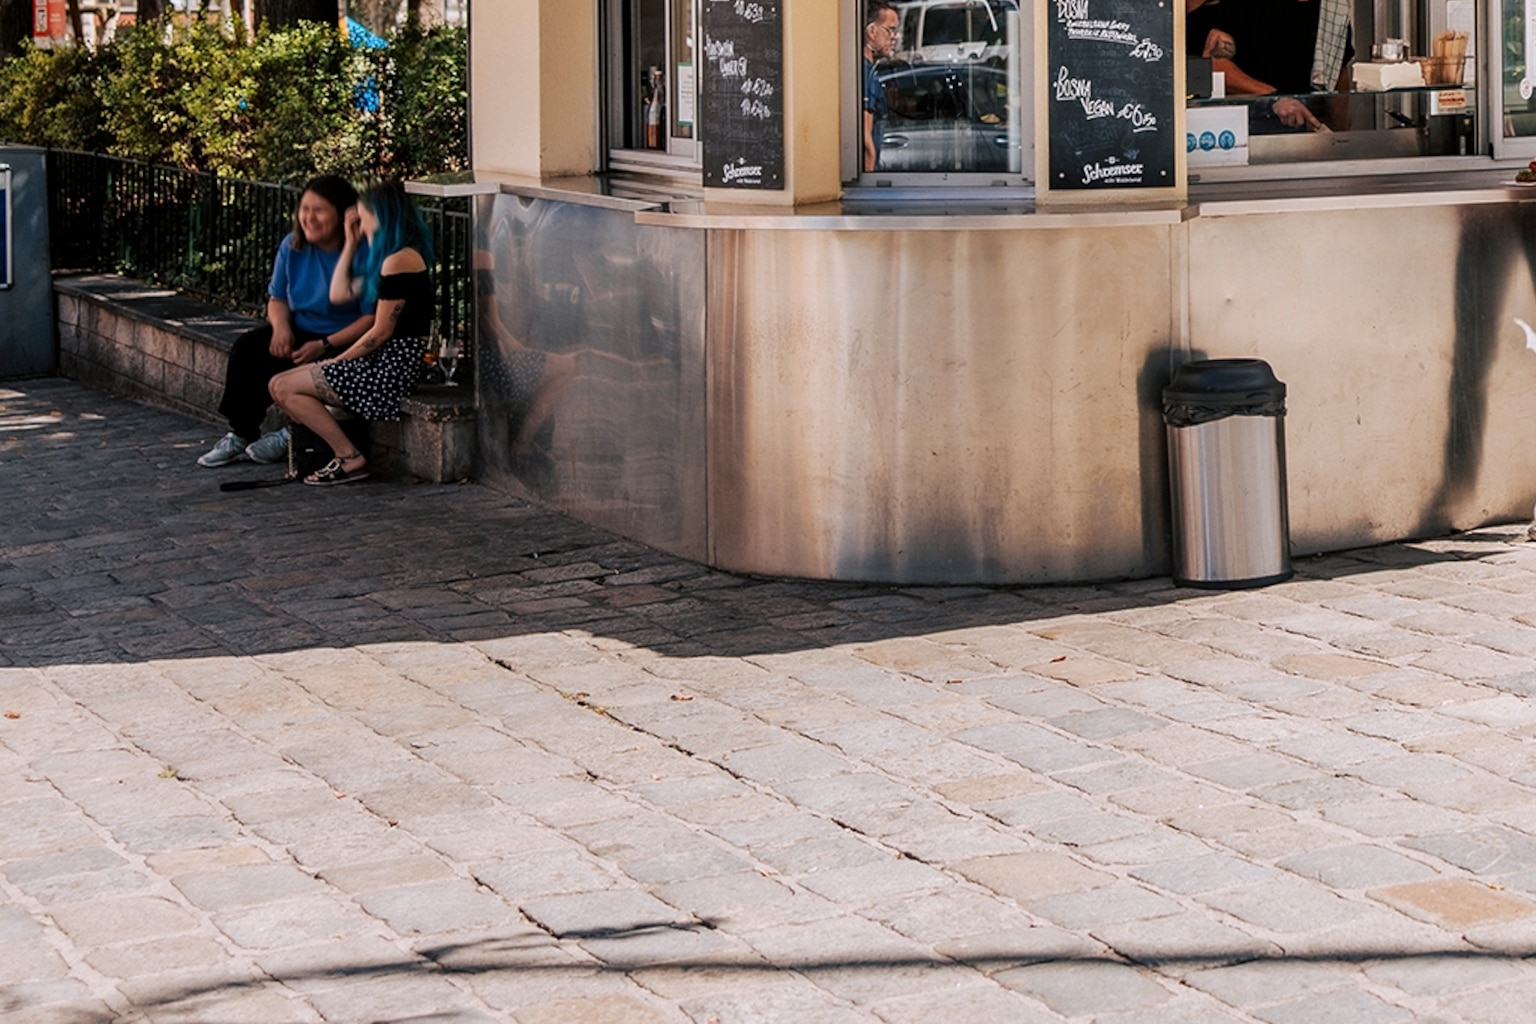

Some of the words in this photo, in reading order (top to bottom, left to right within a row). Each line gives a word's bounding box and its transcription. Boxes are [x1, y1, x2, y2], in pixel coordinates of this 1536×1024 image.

[1056, 65, 1092, 100] BOSNA
[1080, 97, 1115, 119] VEGAN
[1081, 162, 1145, 184] Schremser
